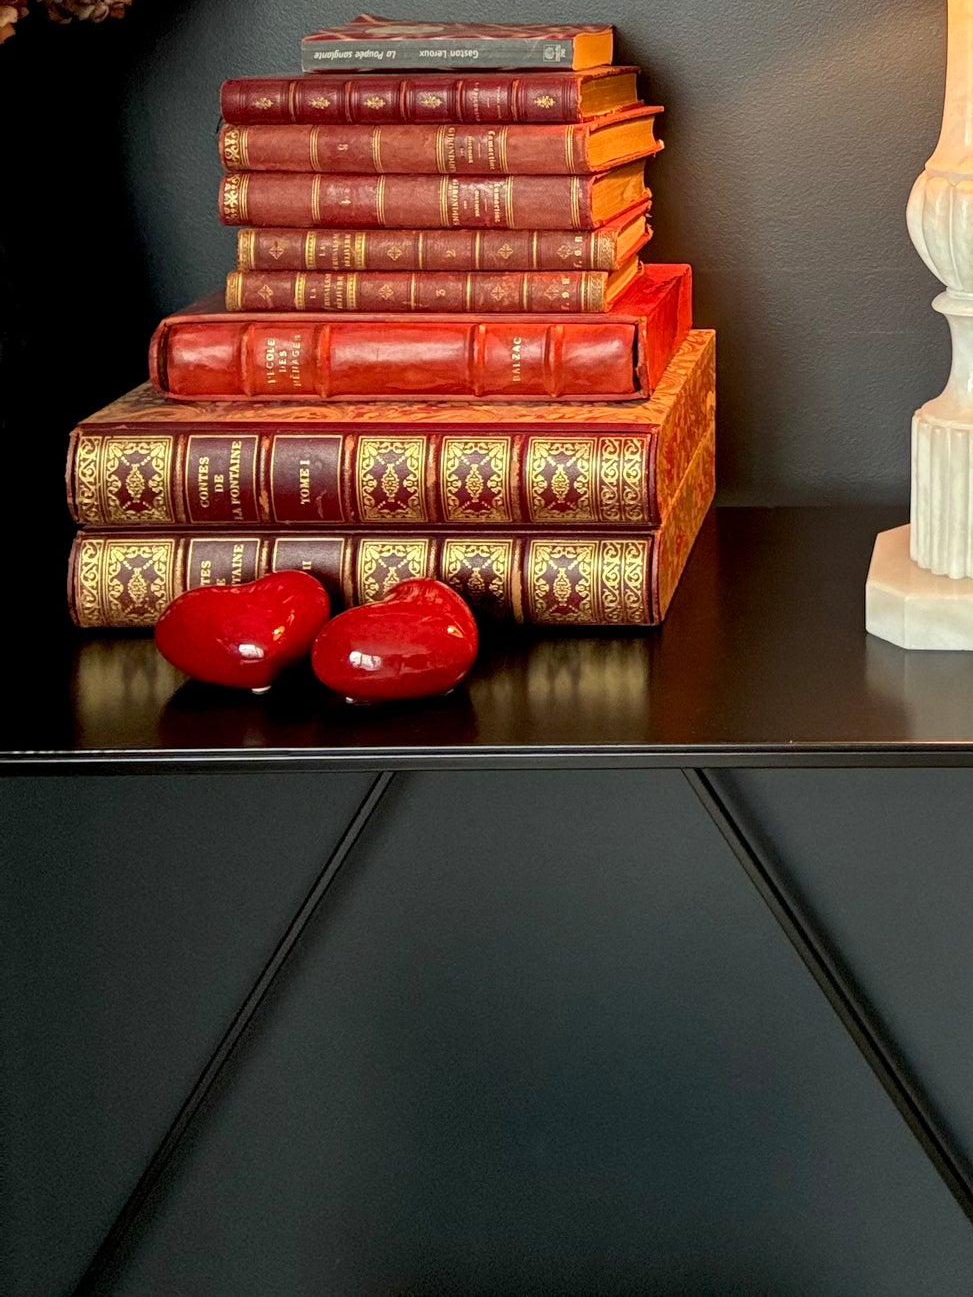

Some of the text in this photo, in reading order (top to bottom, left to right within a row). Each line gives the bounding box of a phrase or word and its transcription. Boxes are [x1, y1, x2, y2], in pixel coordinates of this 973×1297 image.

[313, 49, 397, 60] La Poupée sanglante
[419, 49, 479, 58] Gaston Leroux
[511, 336, 521, 382] BALZAC
[198, 456, 210, 508] CONTES
[214, 474, 224, 493] DE
[229, 440, 244, 521] LA FONTAINE
[300, 468, 311, 505] TOME
[200, 560, 211, 586] TES
[231, 544, 244, 587] TAINE
